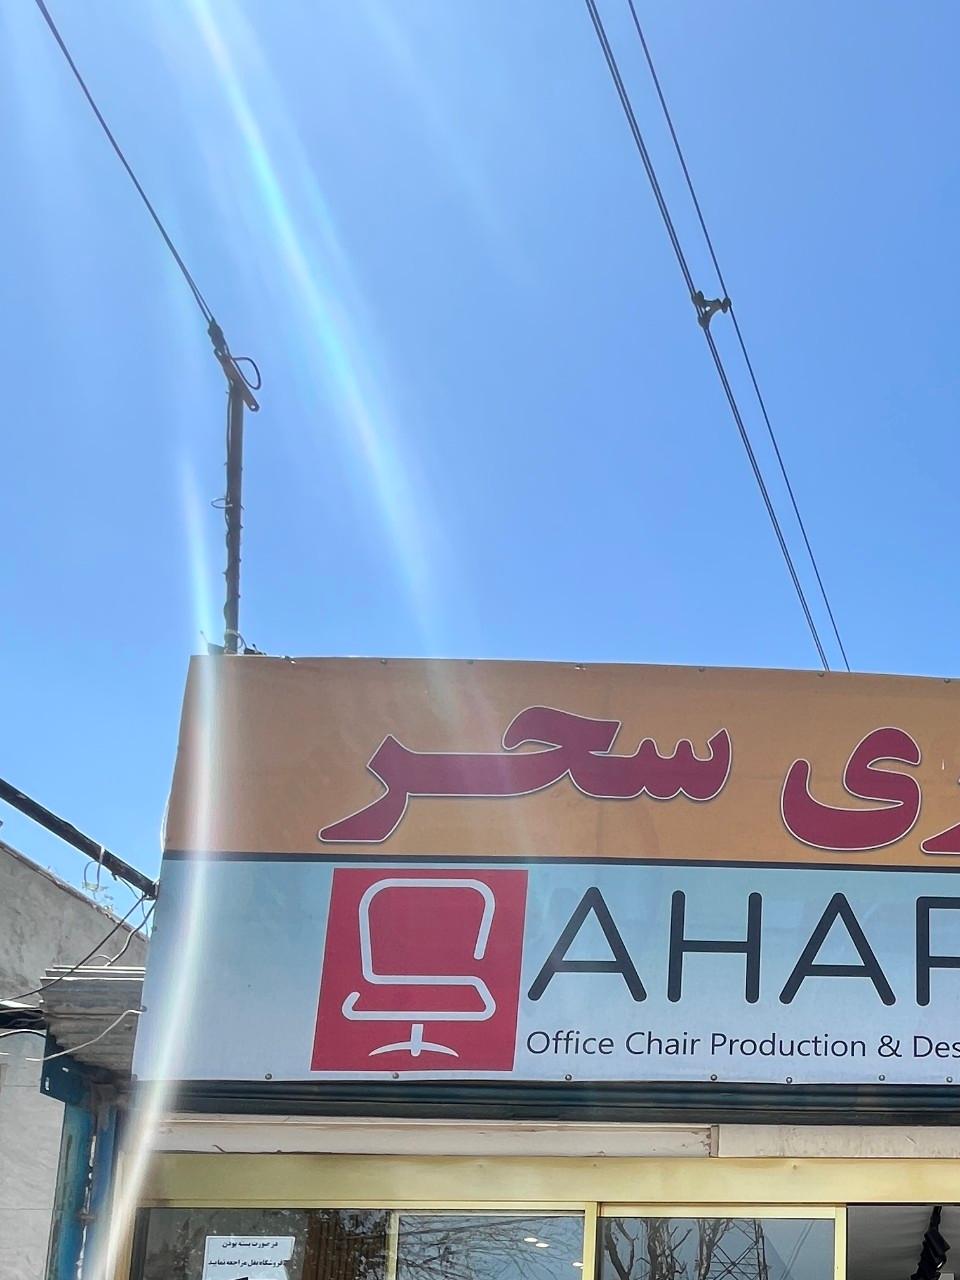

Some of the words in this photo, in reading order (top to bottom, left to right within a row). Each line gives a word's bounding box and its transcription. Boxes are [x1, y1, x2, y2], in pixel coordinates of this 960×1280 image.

[318, 706, 731, 844] سحر
[526, 1030, 615, 1056] Office
[625, 1031, 701, 1056] Chair
[711, 1032, 867, 1058] Production
[877, 1034, 902, 1058] &
